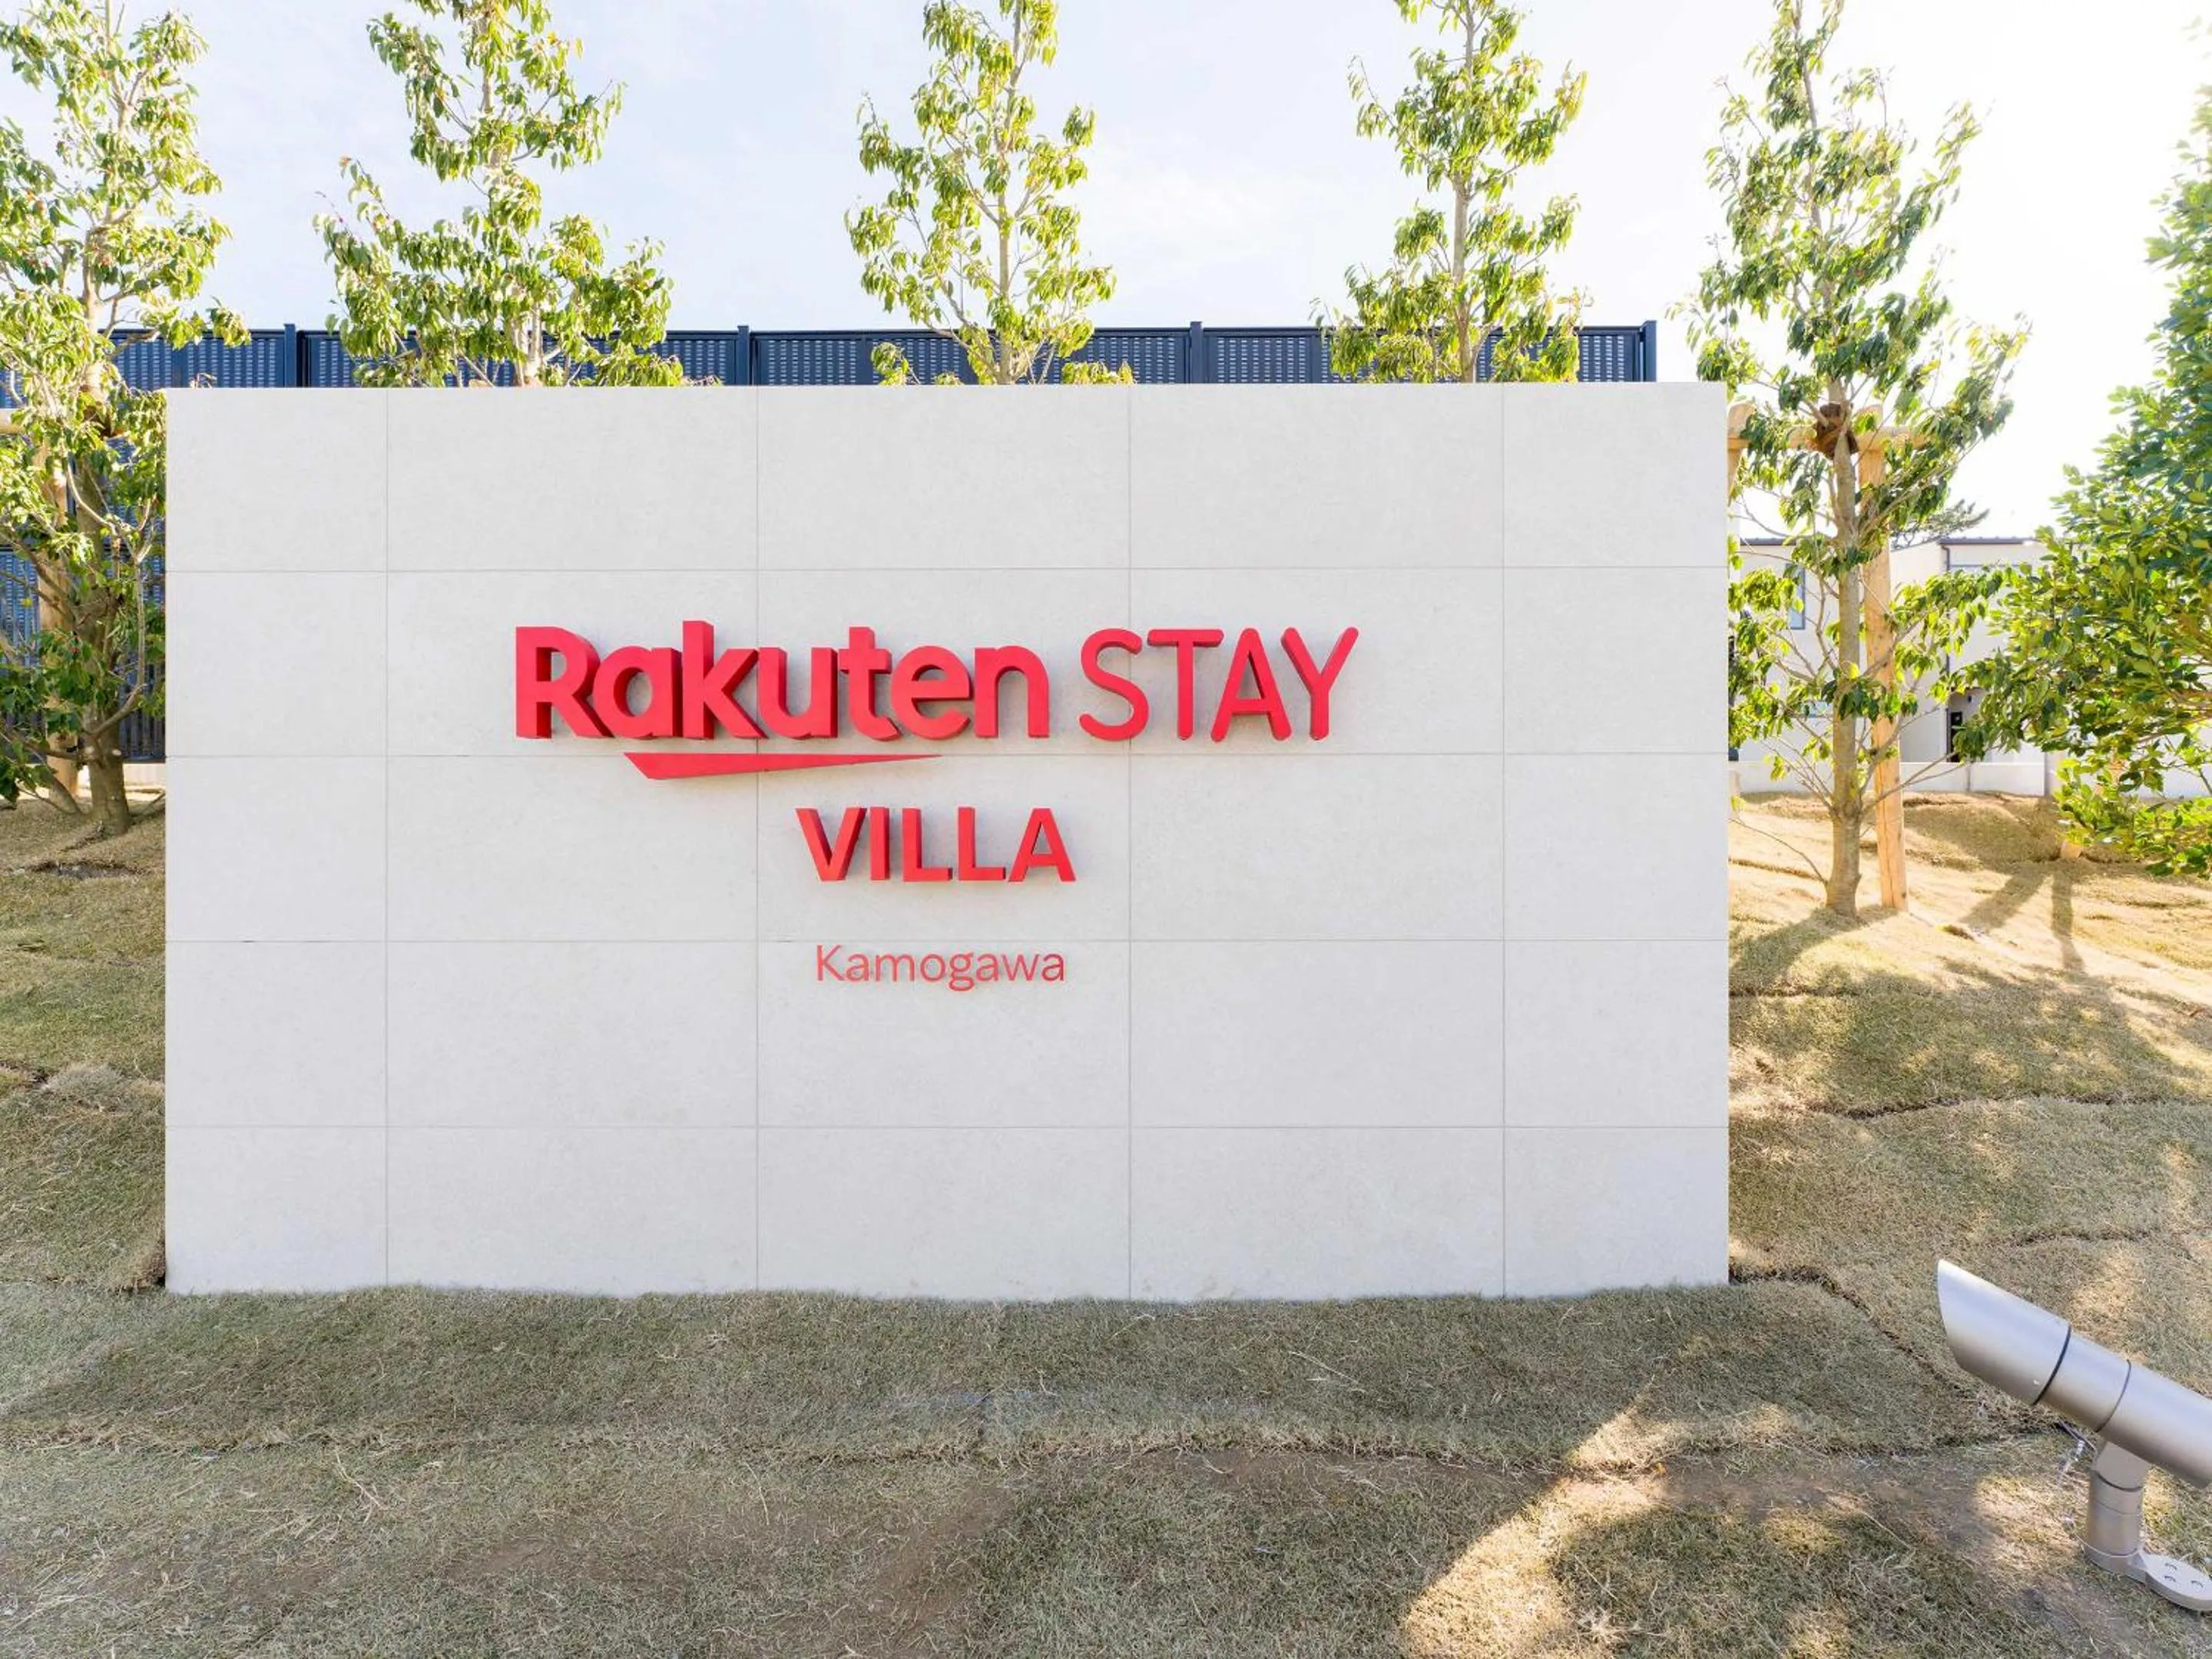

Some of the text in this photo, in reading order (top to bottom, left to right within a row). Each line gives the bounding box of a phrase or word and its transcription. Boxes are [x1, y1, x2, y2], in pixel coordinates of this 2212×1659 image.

[516, 621, 1359, 743] Rakuten STAY
[796, 806, 1076, 883] VILLA
[816, 944, 1065, 992] Kamogawa
